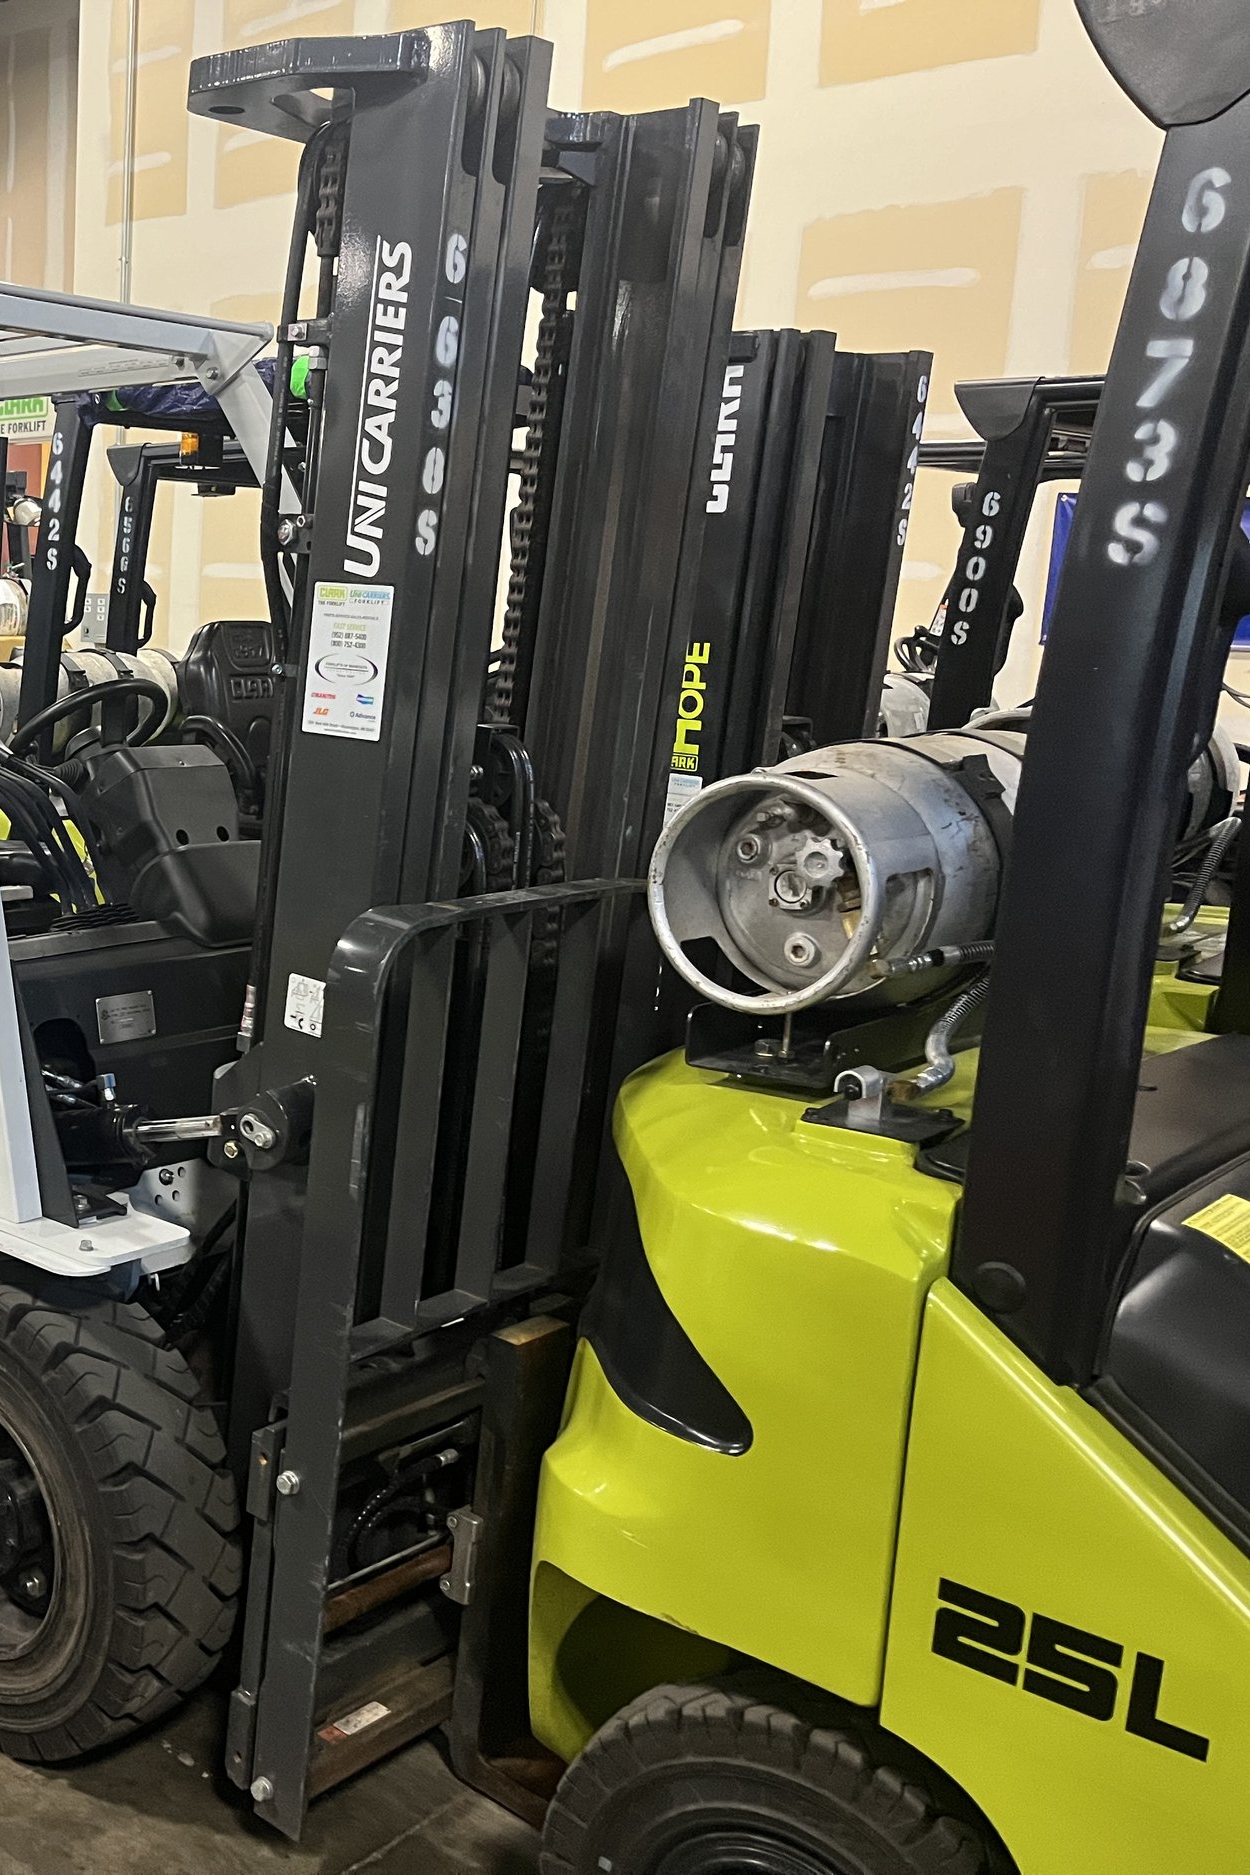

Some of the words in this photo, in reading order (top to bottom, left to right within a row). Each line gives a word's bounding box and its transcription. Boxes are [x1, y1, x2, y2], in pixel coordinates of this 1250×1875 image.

[8, 420, 46, 434] FORKLIFT
[1108, 166, 1231, 566] 6873S
[46, 432, 63, 570] 6442S
[950, 492, 1001, 645] 6900S
[930, 1576, 1210, 1764] 25L
